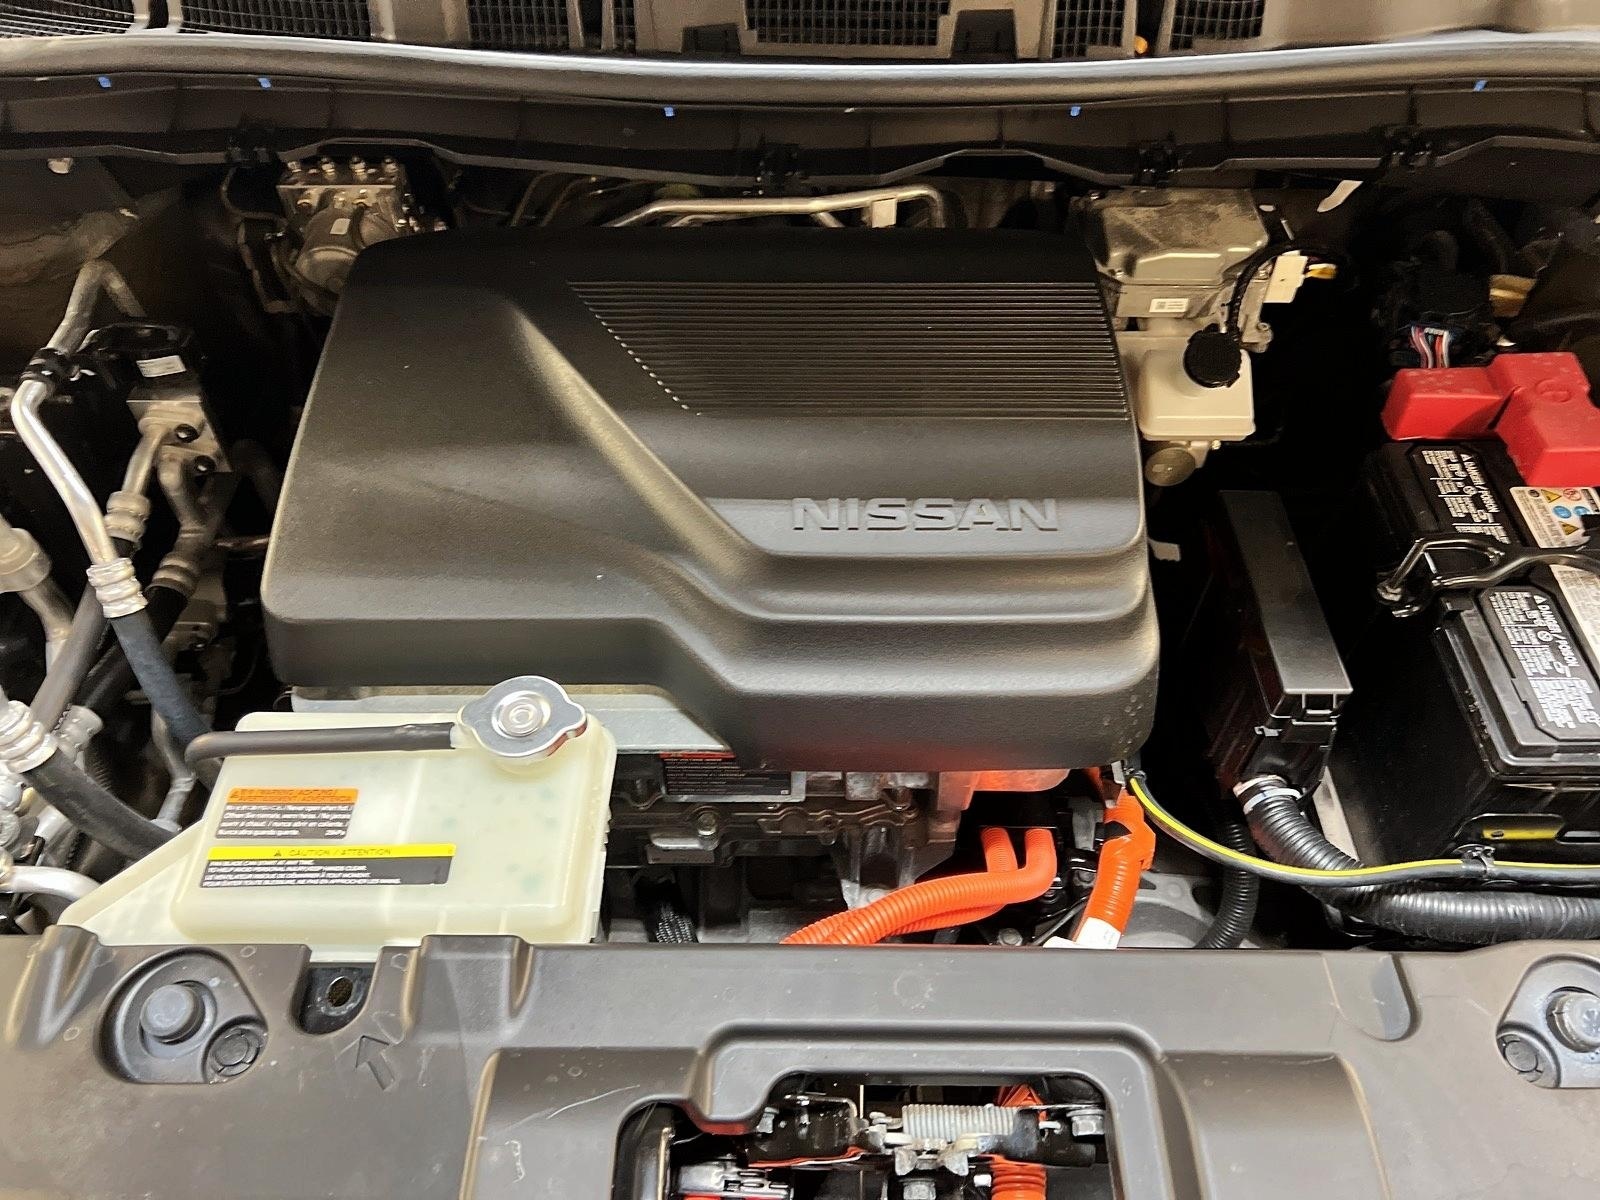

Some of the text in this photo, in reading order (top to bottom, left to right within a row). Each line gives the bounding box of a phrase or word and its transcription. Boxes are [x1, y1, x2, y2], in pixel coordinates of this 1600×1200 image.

[792, 498, 1059, 531] NISSAN
[289, 849, 330, 857] CAUTION
[339, 848, 392, 856] ATTENTION
